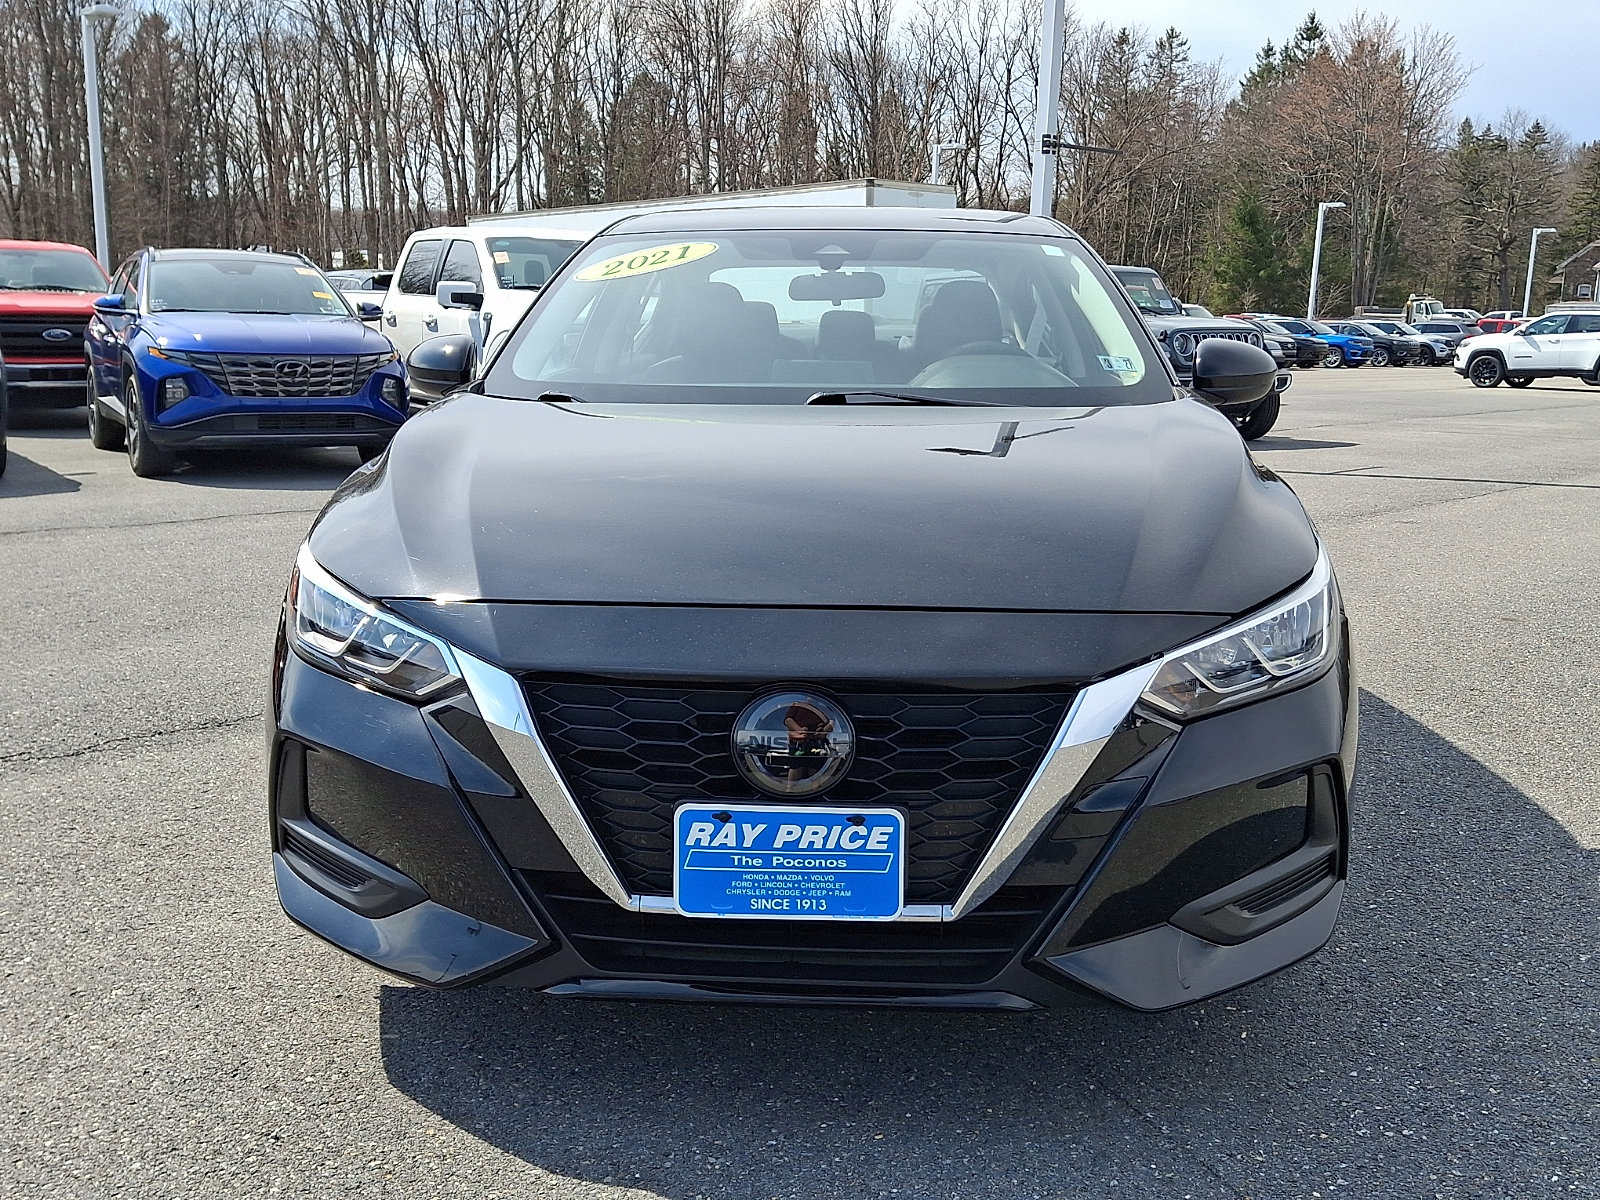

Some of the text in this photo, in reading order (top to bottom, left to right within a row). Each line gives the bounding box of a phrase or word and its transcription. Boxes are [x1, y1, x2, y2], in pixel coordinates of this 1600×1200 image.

[601, 245, 691, 277] 2021
[749, 735, 837, 749] NIS
[685, 822, 894, 850] RAY PRICE
[730, 855, 847, 868] The Poconos
[743, 873, 769, 881] HONDA
[750, 898, 827, 911] SINCE 1913
